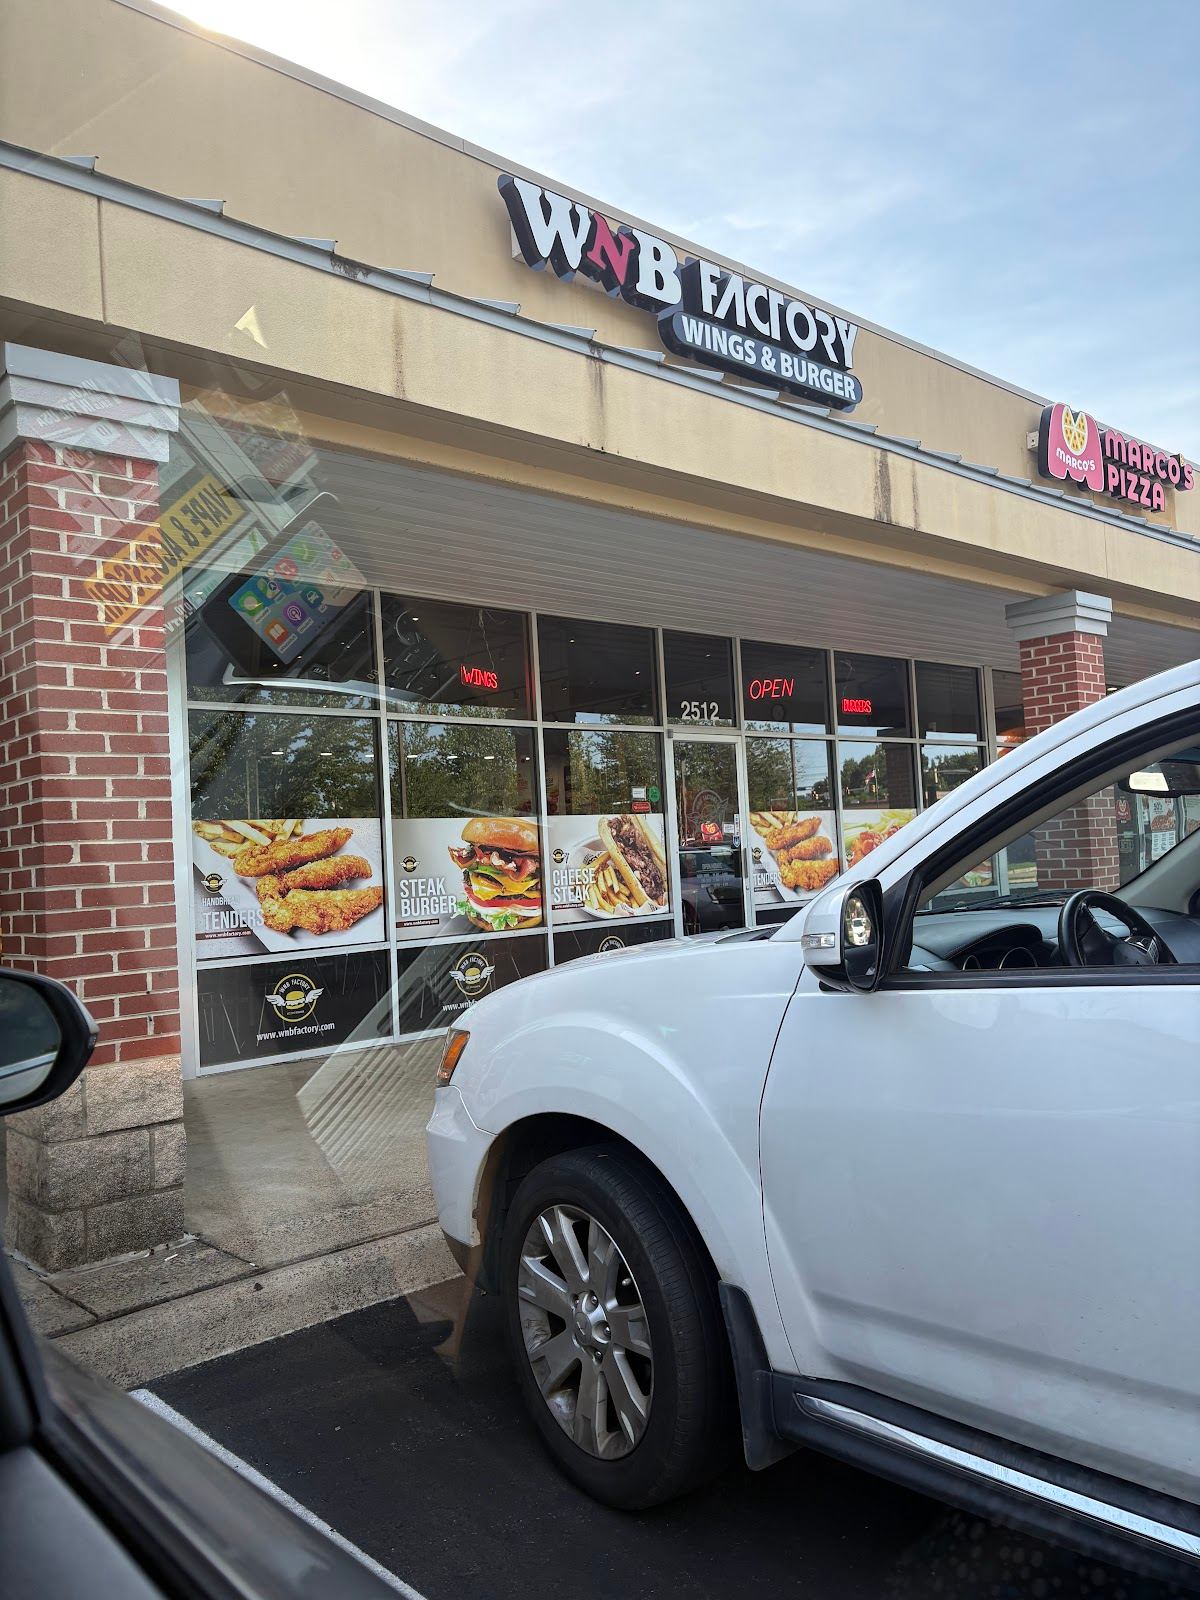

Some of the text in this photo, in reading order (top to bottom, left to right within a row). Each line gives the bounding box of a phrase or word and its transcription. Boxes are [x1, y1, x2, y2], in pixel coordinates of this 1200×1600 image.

[511, 177, 858, 369] WNB FACTORY
[681, 315, 857, 400] WINGS & BURGER
[1056, 447, 1096, 472] MARCO'S
[1105, 429, 1195, 491] MARCO'S
[1108, 464, 1165, 512] PIZZA
[462, 665, 498, 689] WINGS
[750, 679, 794, 699] OPEN
[681, 701, 720, 720] 2512
[400, 877, 446, 898] STEAK
[552, 867, 597, 887] CHEESE
[752, 872, 781, 886] TENDERS
[553, 885, 590, 903] STEAK
[401, 895, 458, 918] BURGER
[203, 909, 264, 931] TENDERS
[279, 979, 311, 993] WNB FACTORY
[256, 1022, 335, 1041] www.wnbfactory.com
